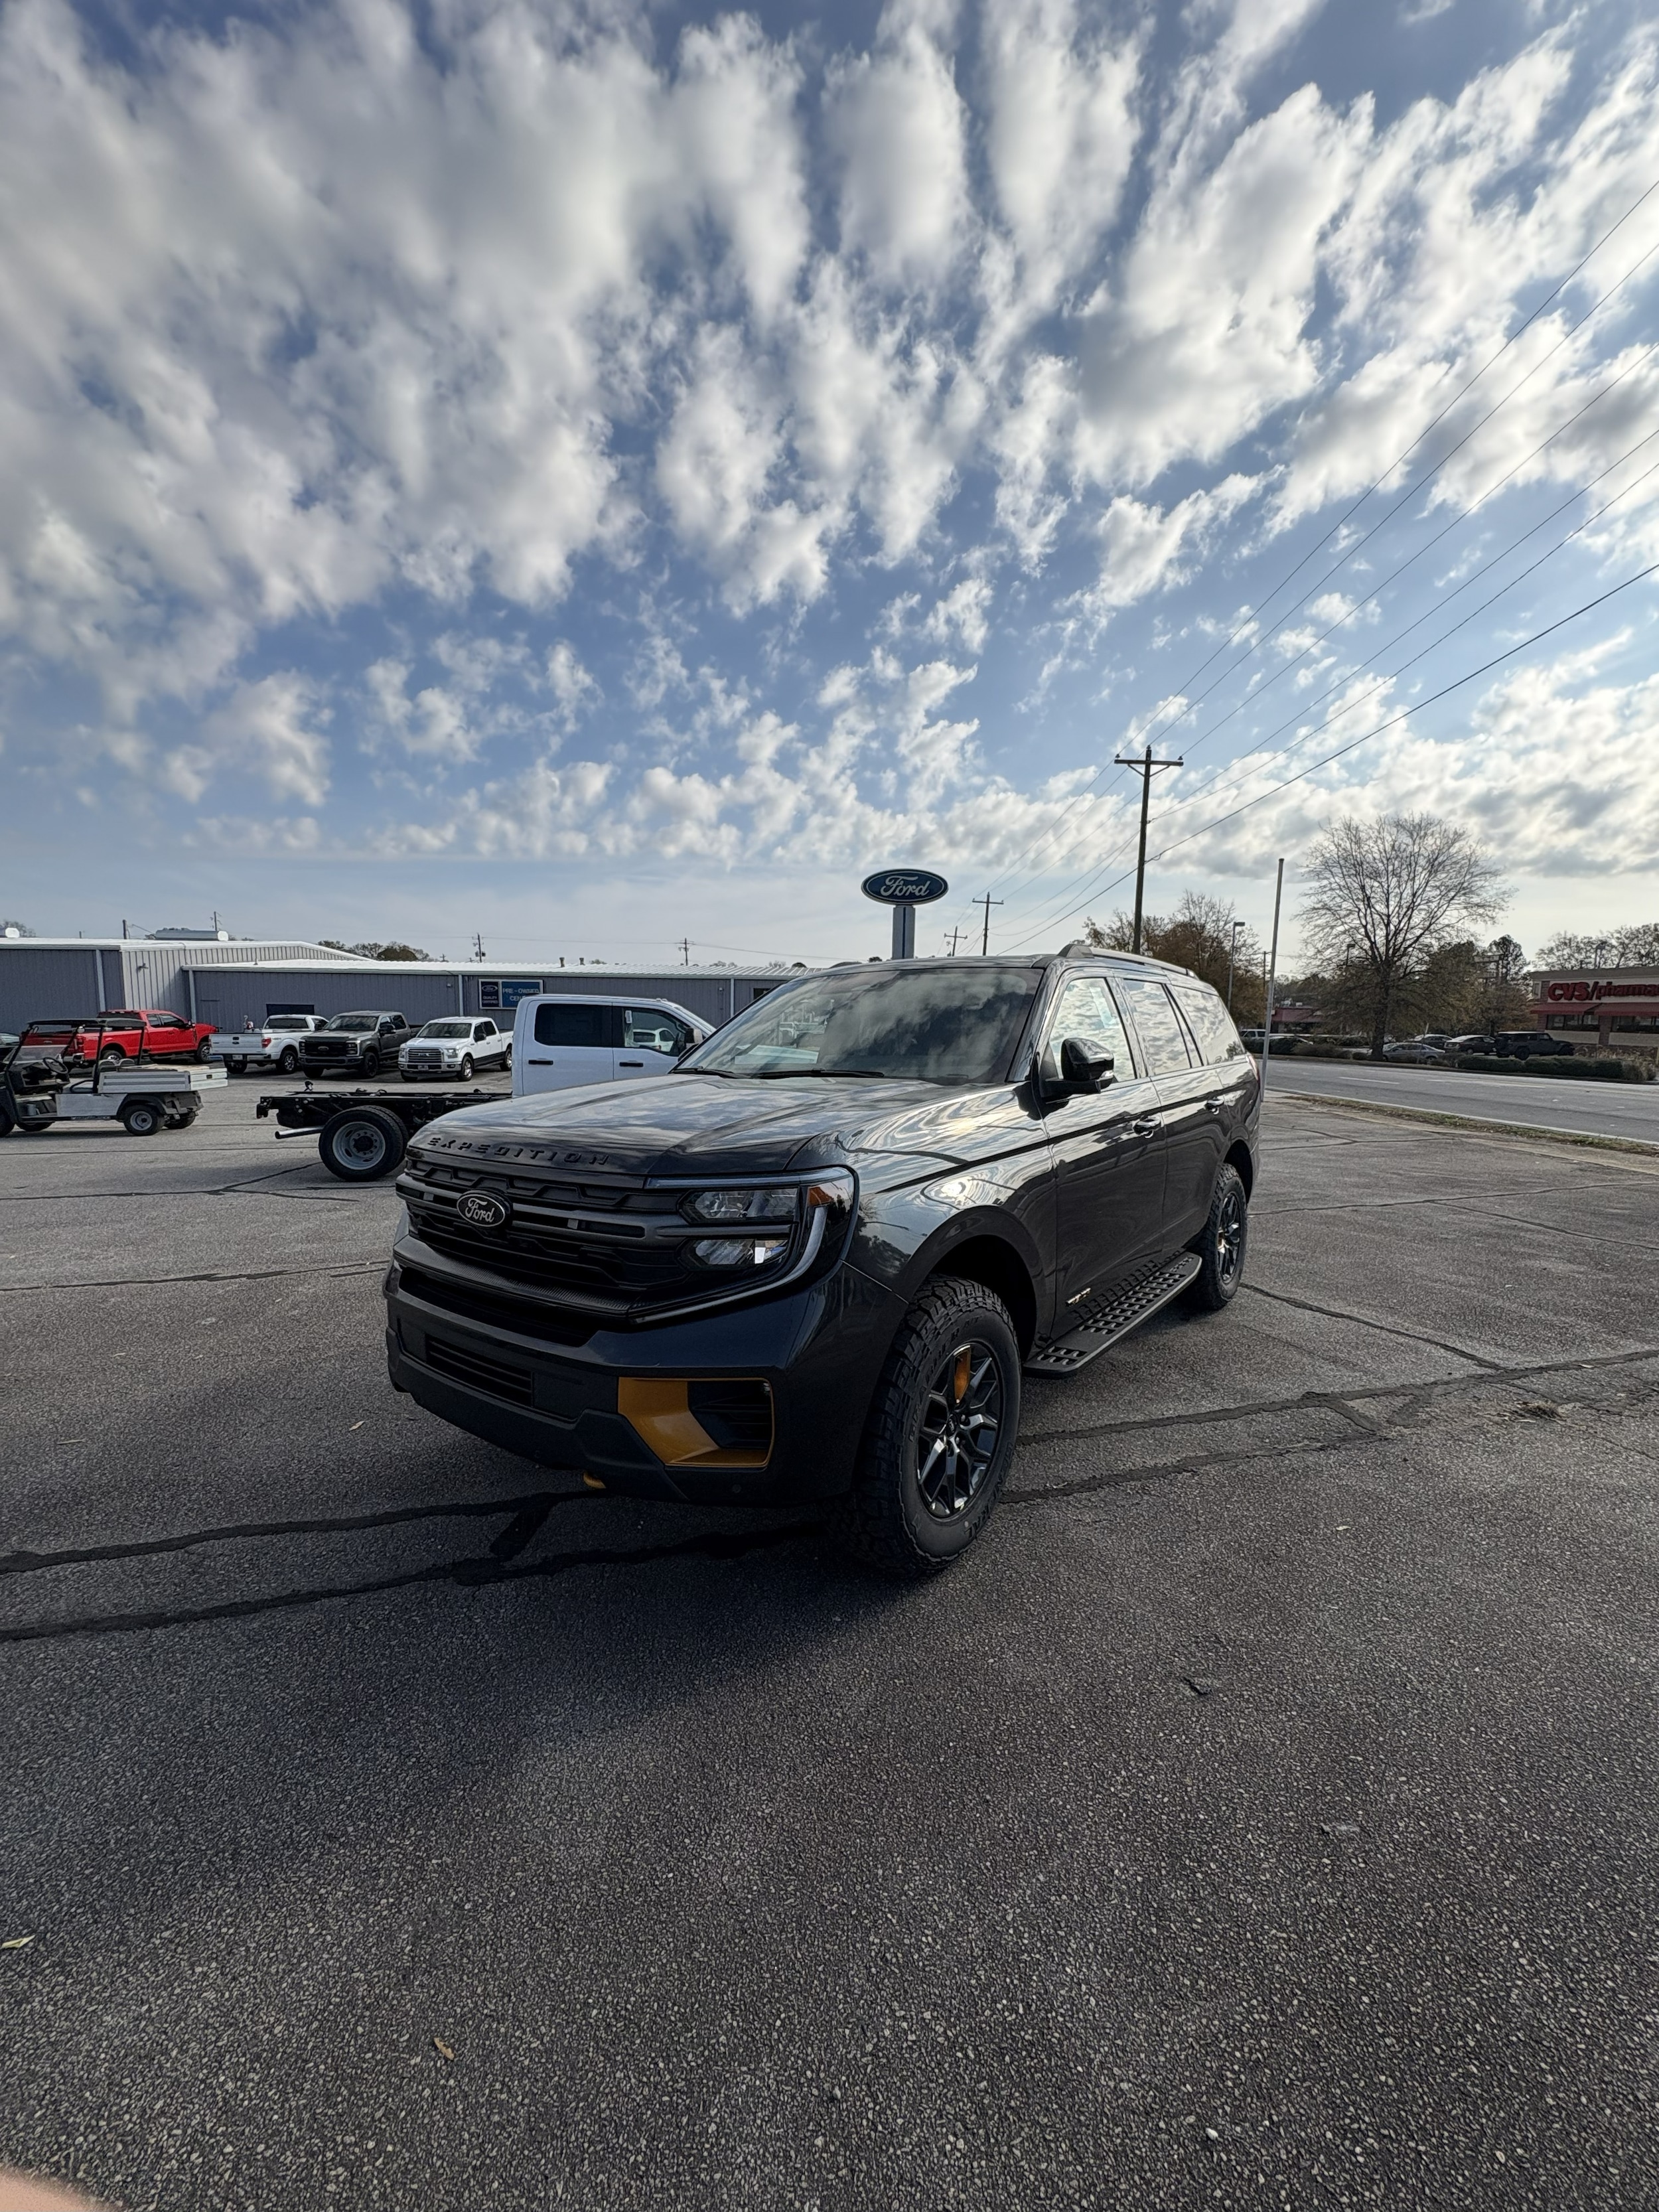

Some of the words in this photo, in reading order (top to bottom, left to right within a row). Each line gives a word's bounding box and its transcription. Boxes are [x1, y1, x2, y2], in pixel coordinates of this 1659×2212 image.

[880, 875, 930, 896] Ford
[427, 1137, 609, 1165] EXPEDITION
[465, 1197, 495, 1223] Ford
